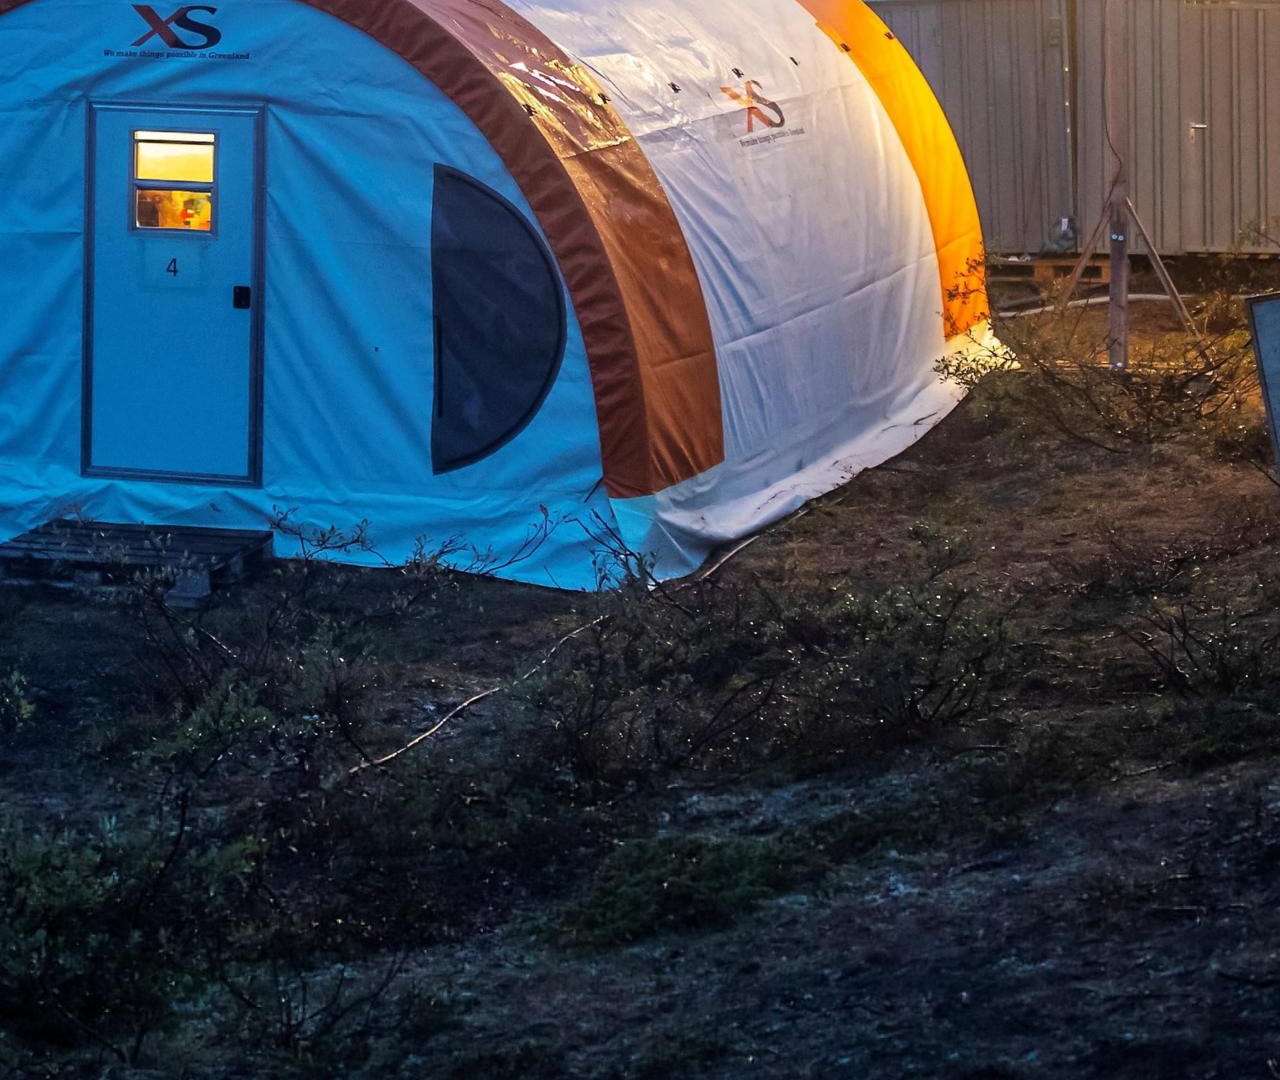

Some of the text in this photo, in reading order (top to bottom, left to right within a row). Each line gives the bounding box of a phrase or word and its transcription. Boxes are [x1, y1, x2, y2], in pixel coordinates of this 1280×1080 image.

[130, 4, 223, 50] XS
[720, 80, 786, 133] XS
[166, 258, 179, 277] 4
